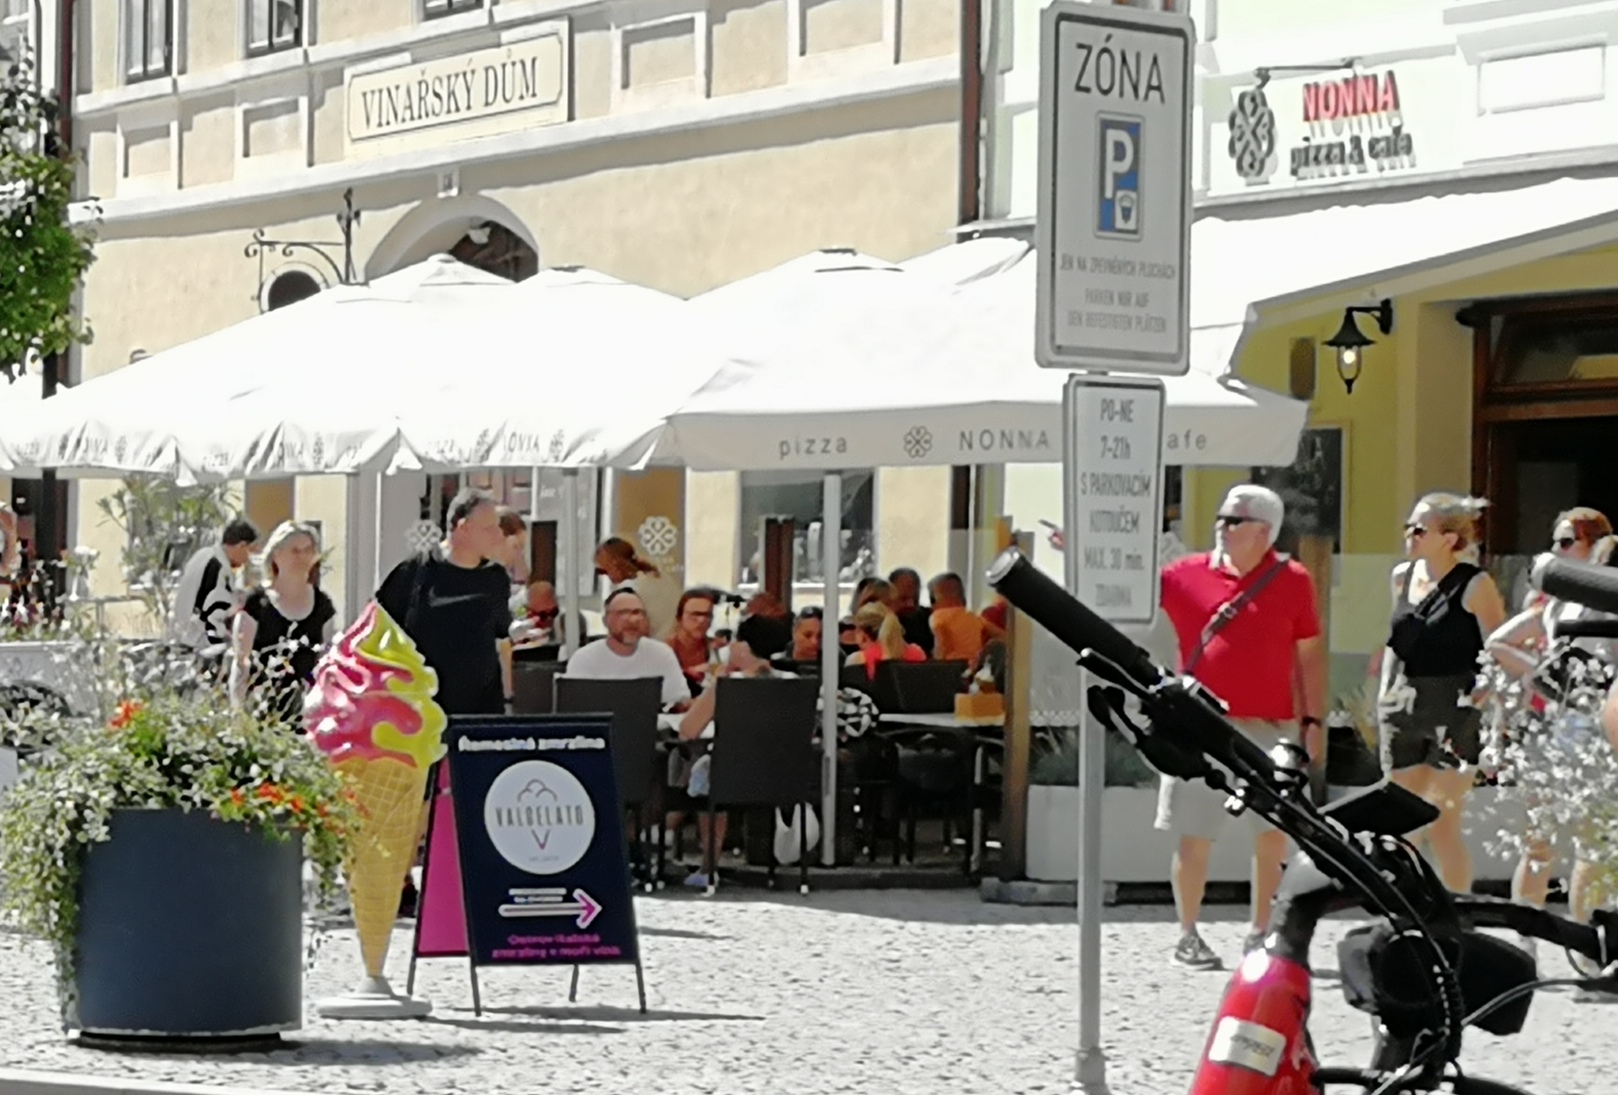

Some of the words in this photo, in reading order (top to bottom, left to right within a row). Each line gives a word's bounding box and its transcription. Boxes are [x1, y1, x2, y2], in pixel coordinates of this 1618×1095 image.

[1074, 33, 1166, 104] ZÓNA
[361, 57, 476, 130] VINAŘSKÝ
[483, 47, 538, 108] DŮM
[1302, 70, 1401, 122] NONNA
[1104, 128, 1134, 199] P
[1290, 135, 1347, 177] pizza
[1349, 135, 1366, 166] &
[1076, 255, 1088, 273] NA
[1084, 287, 1115, 306] PARKEN
[1117, 290, 1133, 308] NUR
[1134, 291, 1151, 309] AUF
[1100, 397, 1135, 423] PO-NE
[778, 435, 849, 461] pizza
[957, 428, 1050, 452] NONNA
[1166, 428, 1208, 451] afe
[1100, 434, 1132, 460] 7-21h
[1080, 471, 1089, 496] S
[1089, 467, 1152, 498] PARKOVACÍM
[1088, 503, 1141, 534] KOTOUČEM
[1083, 545, 1108, 570] MAX.
[1109, 546, 1123, 571] 30
[1124, 547, 1146, 571] min.
